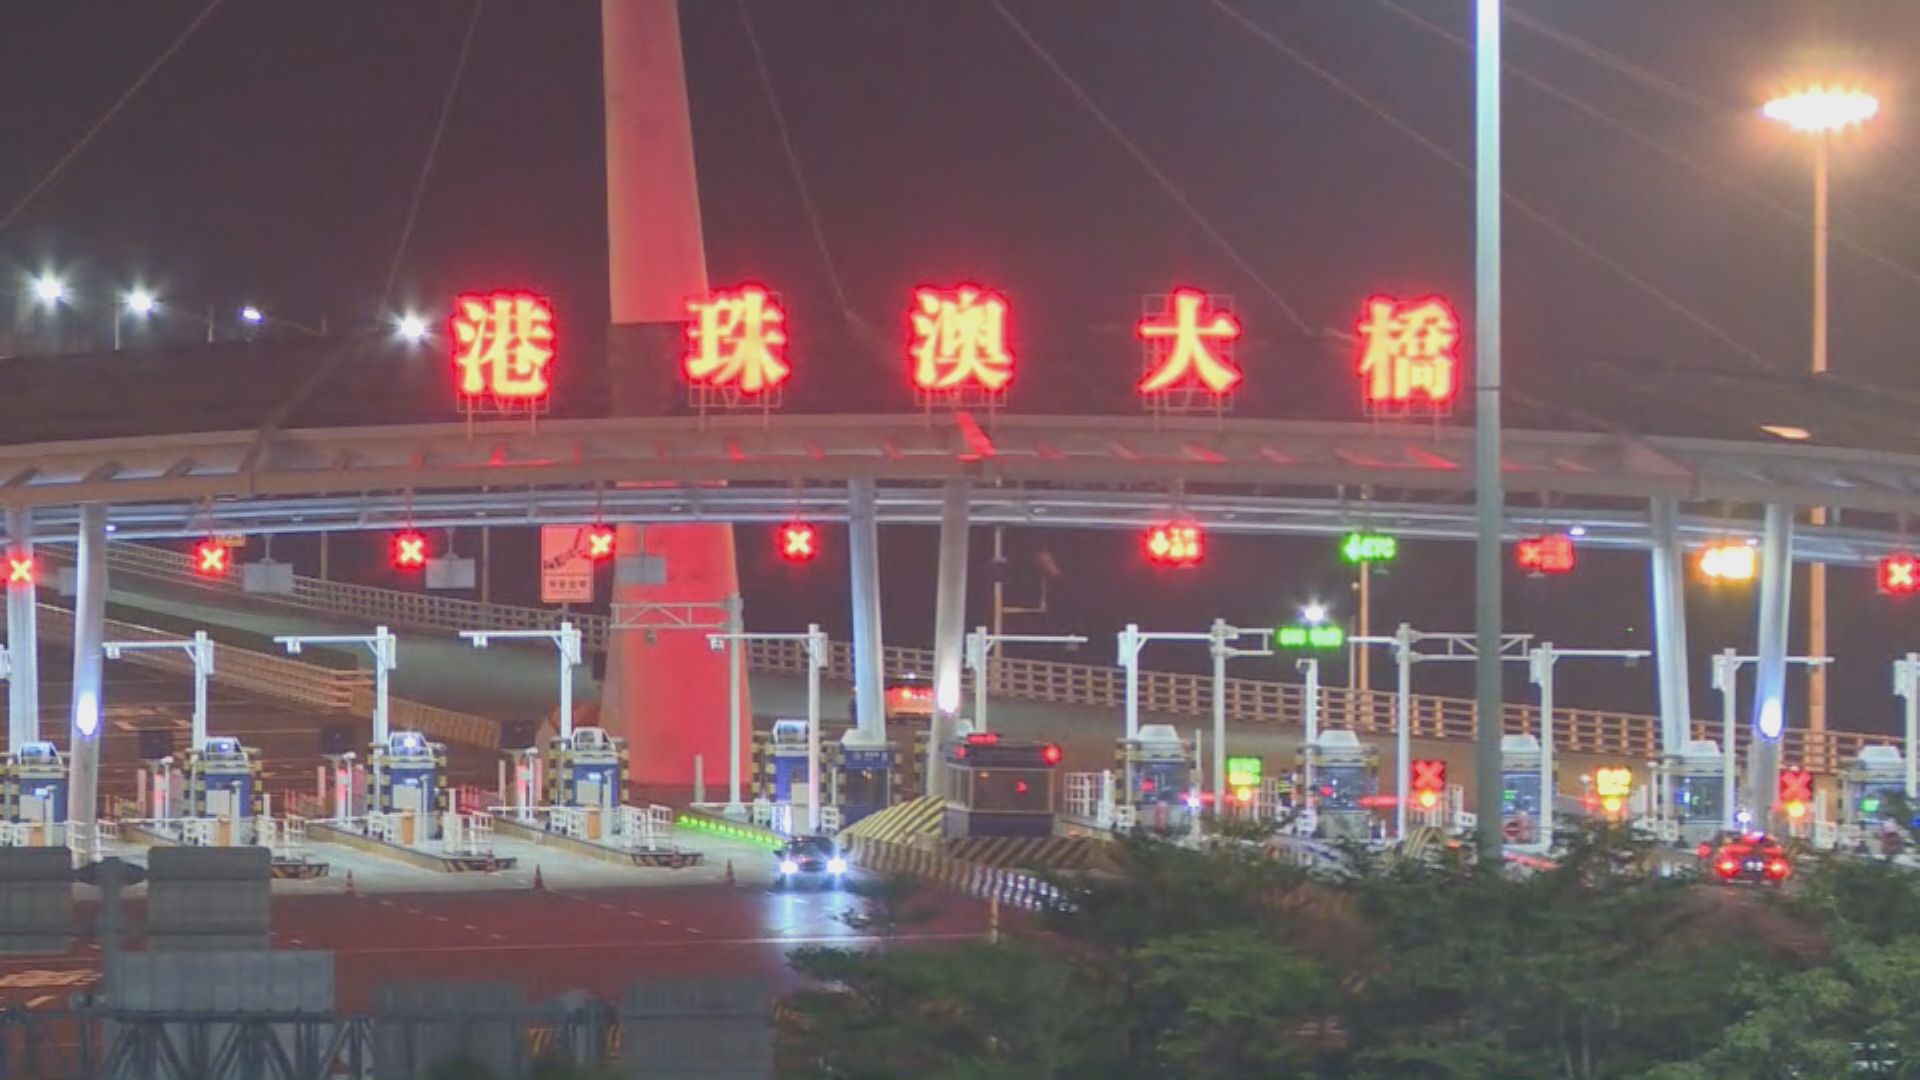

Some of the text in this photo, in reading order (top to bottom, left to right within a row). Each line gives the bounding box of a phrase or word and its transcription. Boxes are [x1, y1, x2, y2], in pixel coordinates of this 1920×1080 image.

[454, 290, 1454, 399] 港珠澳大橋
